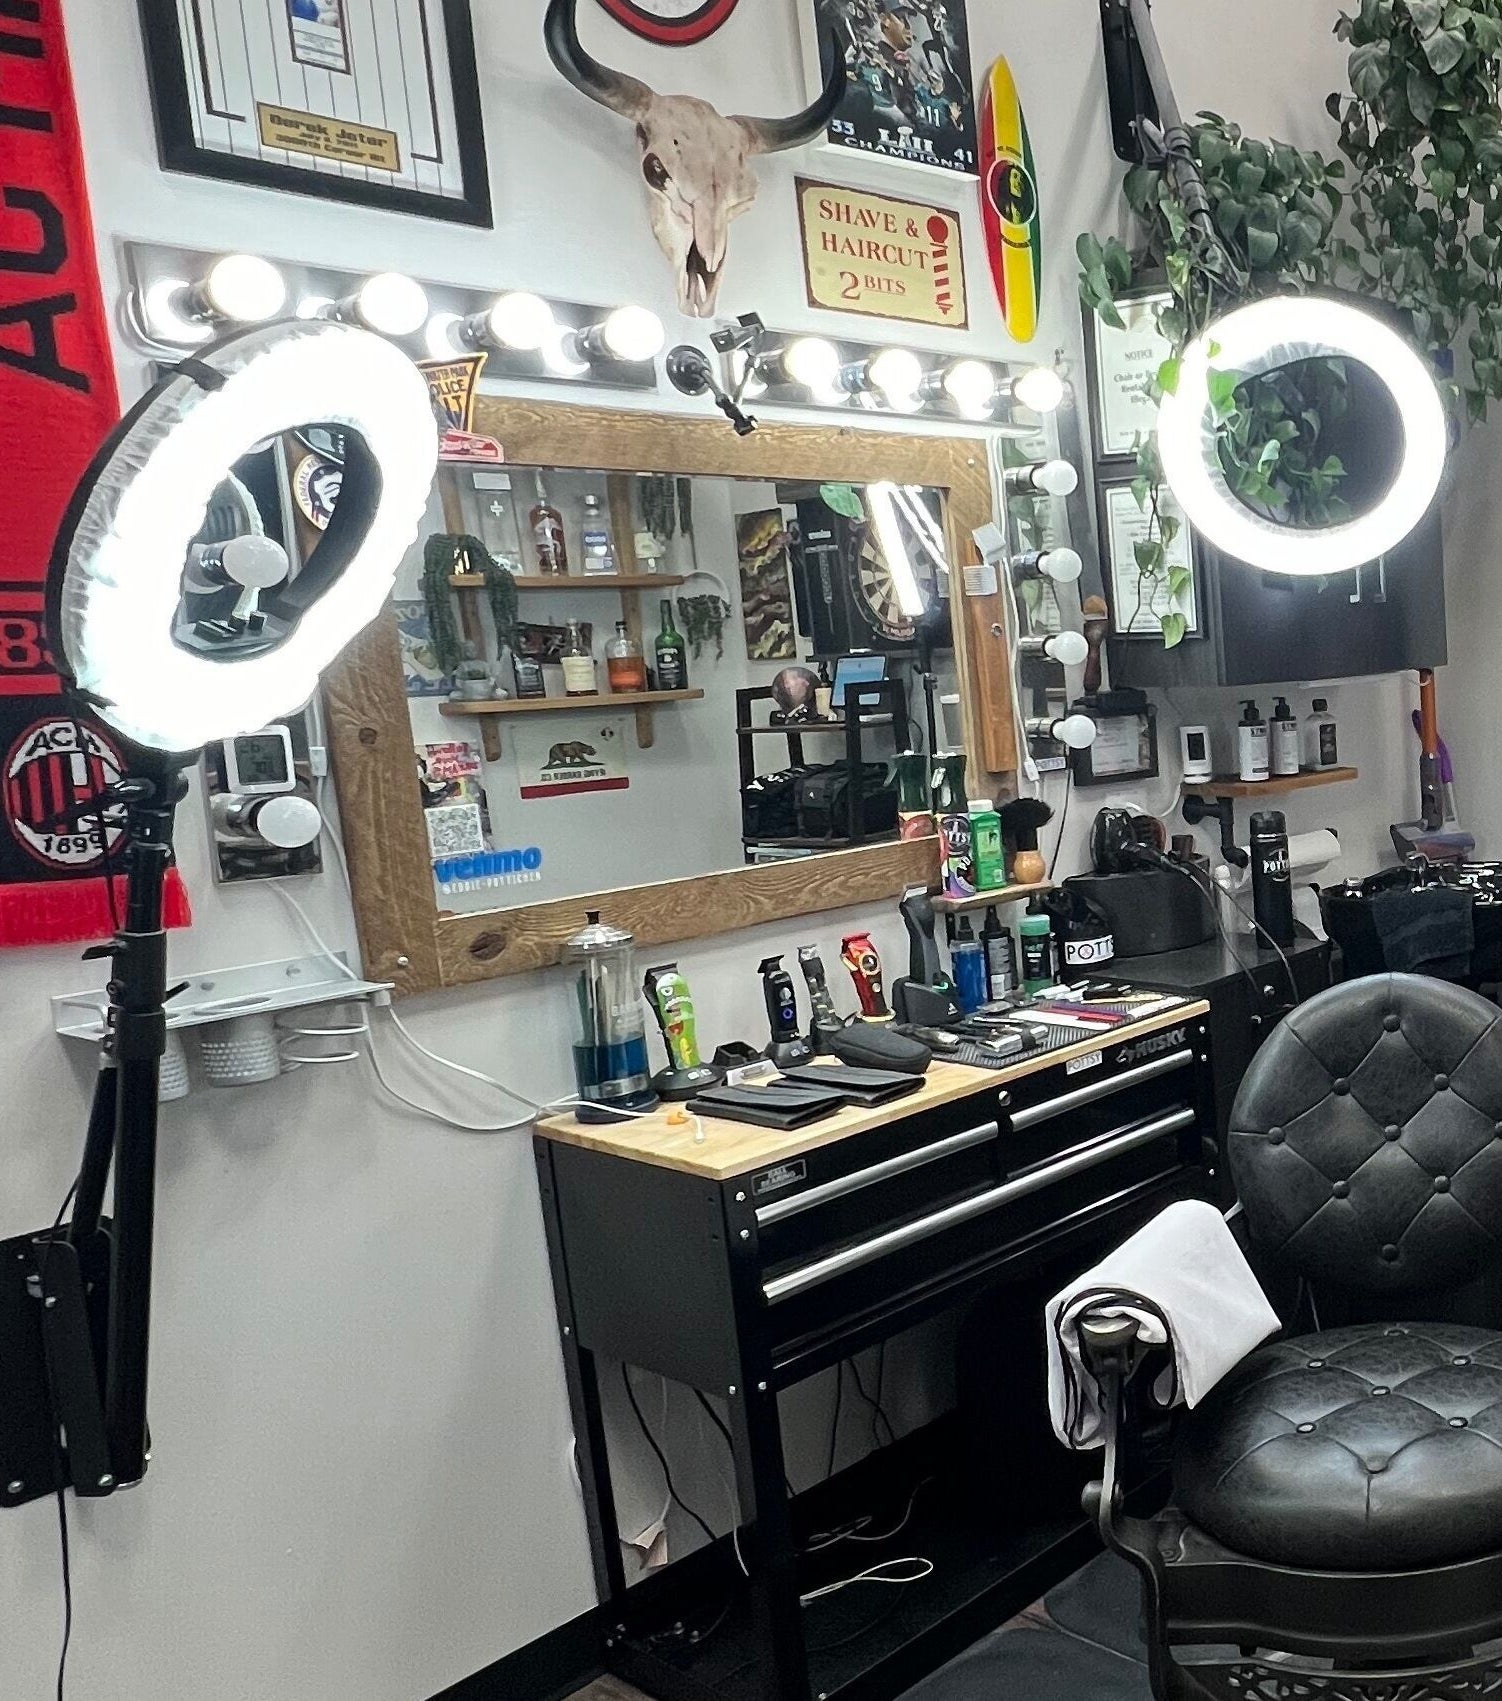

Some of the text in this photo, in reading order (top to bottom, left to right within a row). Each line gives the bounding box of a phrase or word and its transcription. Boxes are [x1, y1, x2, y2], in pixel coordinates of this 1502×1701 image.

[844, 136, 966, 171] CHAMPIONS
[953, 148, 974, 164] 41
[819, 198, 920, 239] SHAVE &
[821, 231, 929, 270] HAIRCUT
[839, 271, 906, 301] 2 BITS
[428, 379, 467, 397] OLICE
[433, 847, 542, 883] venmo
[1066, 939, 1114, 961] POTT
[1136, 1026, 1187, 1059] HUSKY
[1066, 1052, 1101, 1072] POTTSY
